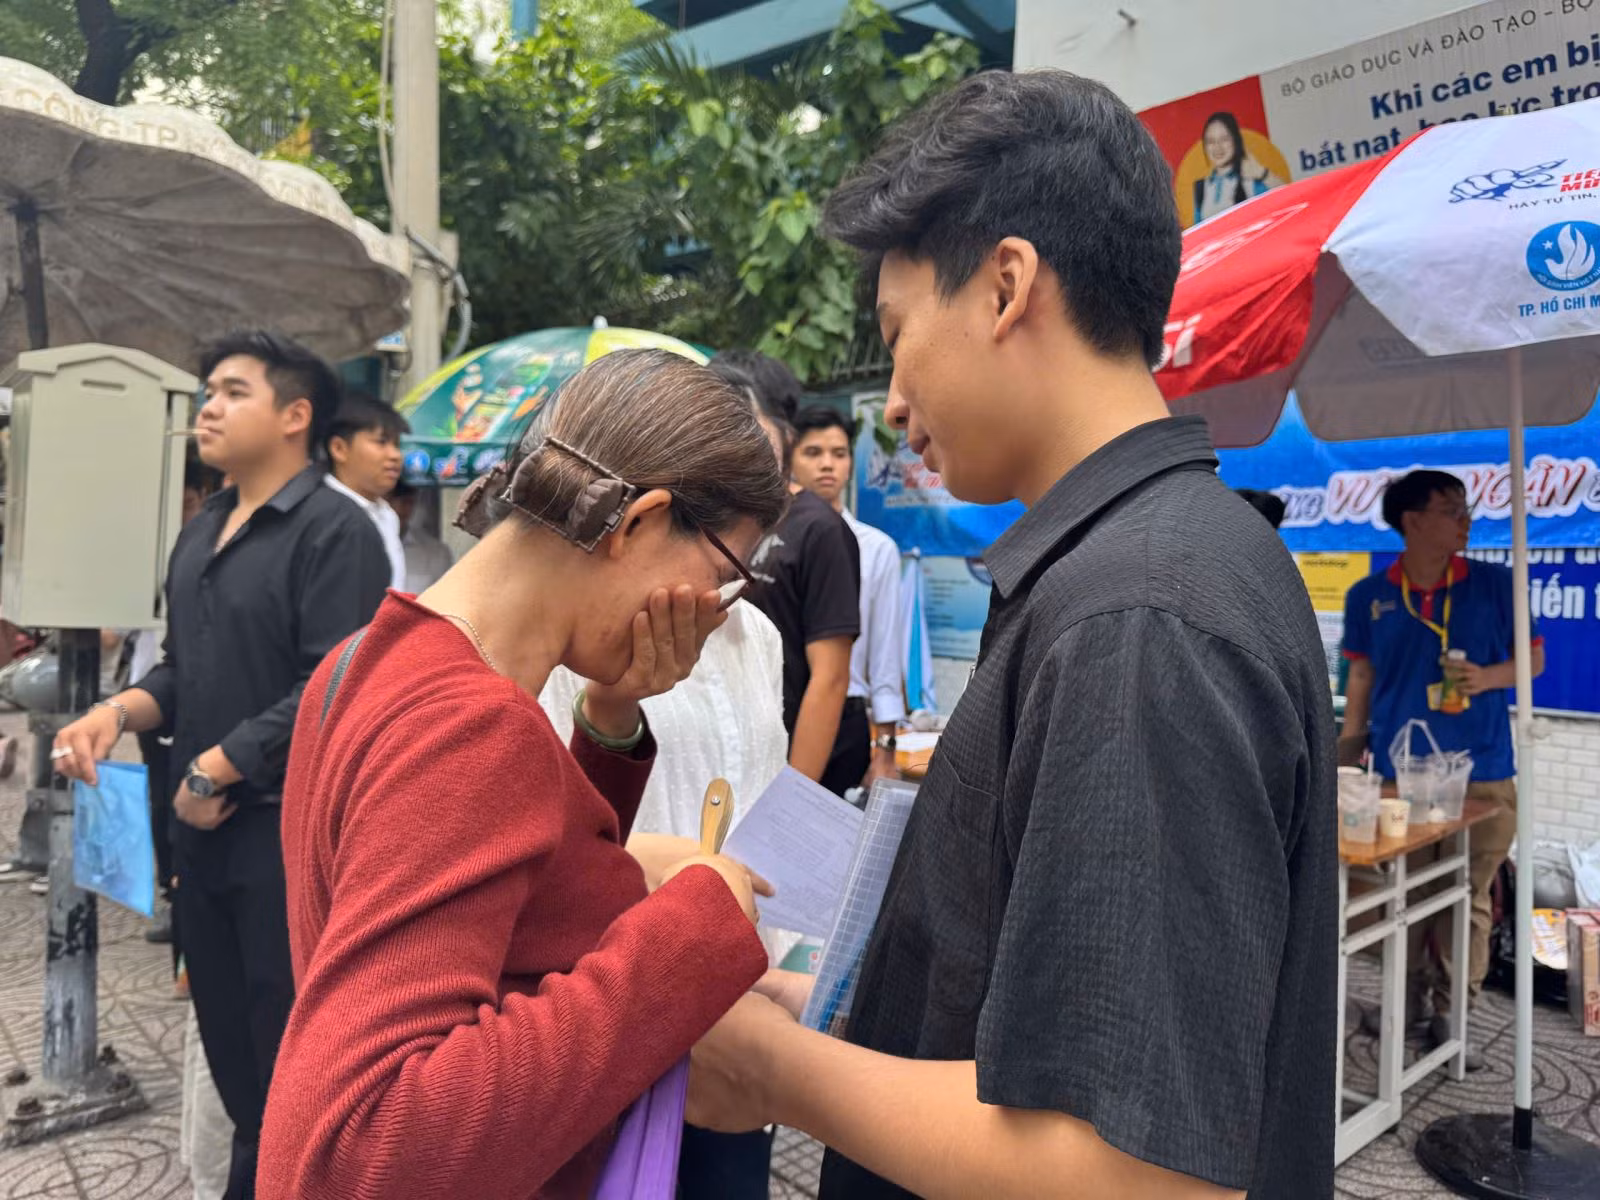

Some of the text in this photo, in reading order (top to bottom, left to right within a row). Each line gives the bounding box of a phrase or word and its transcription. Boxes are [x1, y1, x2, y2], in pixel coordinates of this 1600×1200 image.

[1441, 24, 1485, 50] ĐÀO
[1492, 9, 1537, 33] TẠO
[1370, 33, 1600, 120] Khi các em bị
[1517, 303, 1537, 318] TP.
